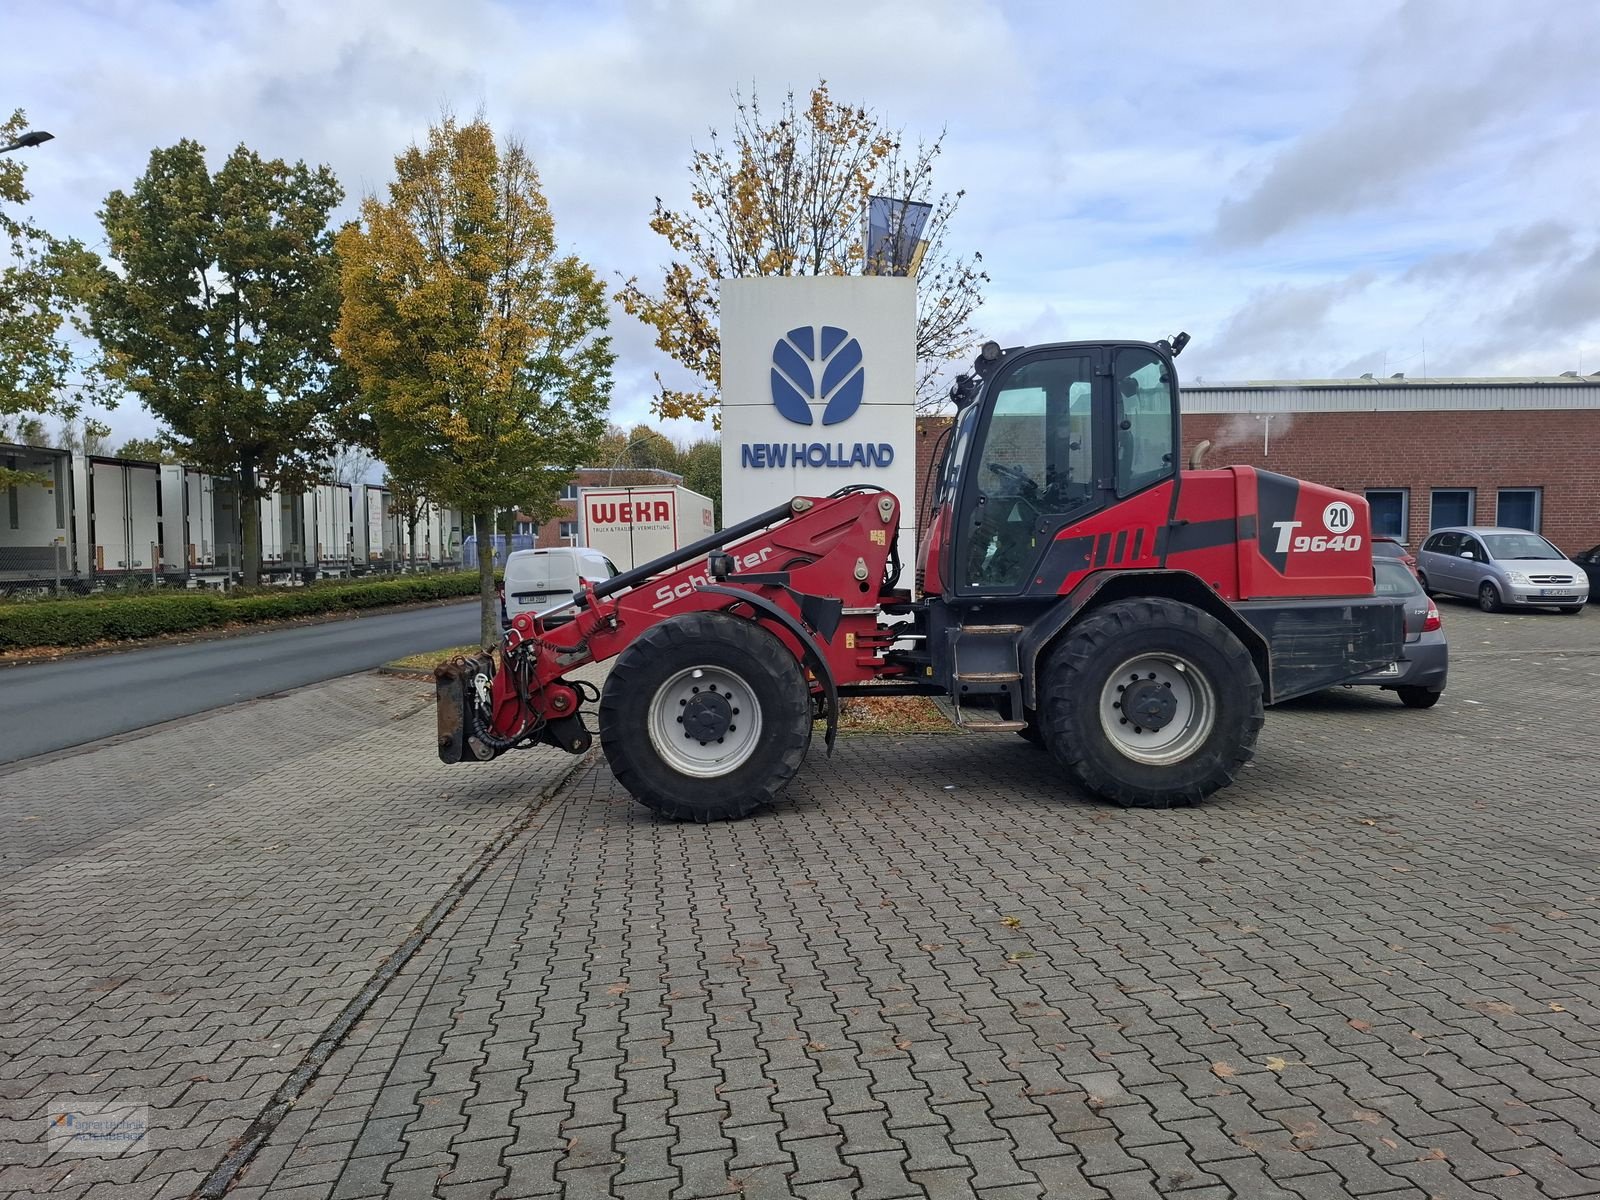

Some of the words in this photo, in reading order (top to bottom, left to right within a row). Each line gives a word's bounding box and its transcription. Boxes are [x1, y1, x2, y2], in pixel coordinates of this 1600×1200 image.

[741, 443, 788, 468] NEW
[791, 442, 894, 468] HOLLAND
[591, 501, 670, 524] WEKA
[1329, 508, 1348, 527] 20
[652, 546, 773, 609] Schfer
